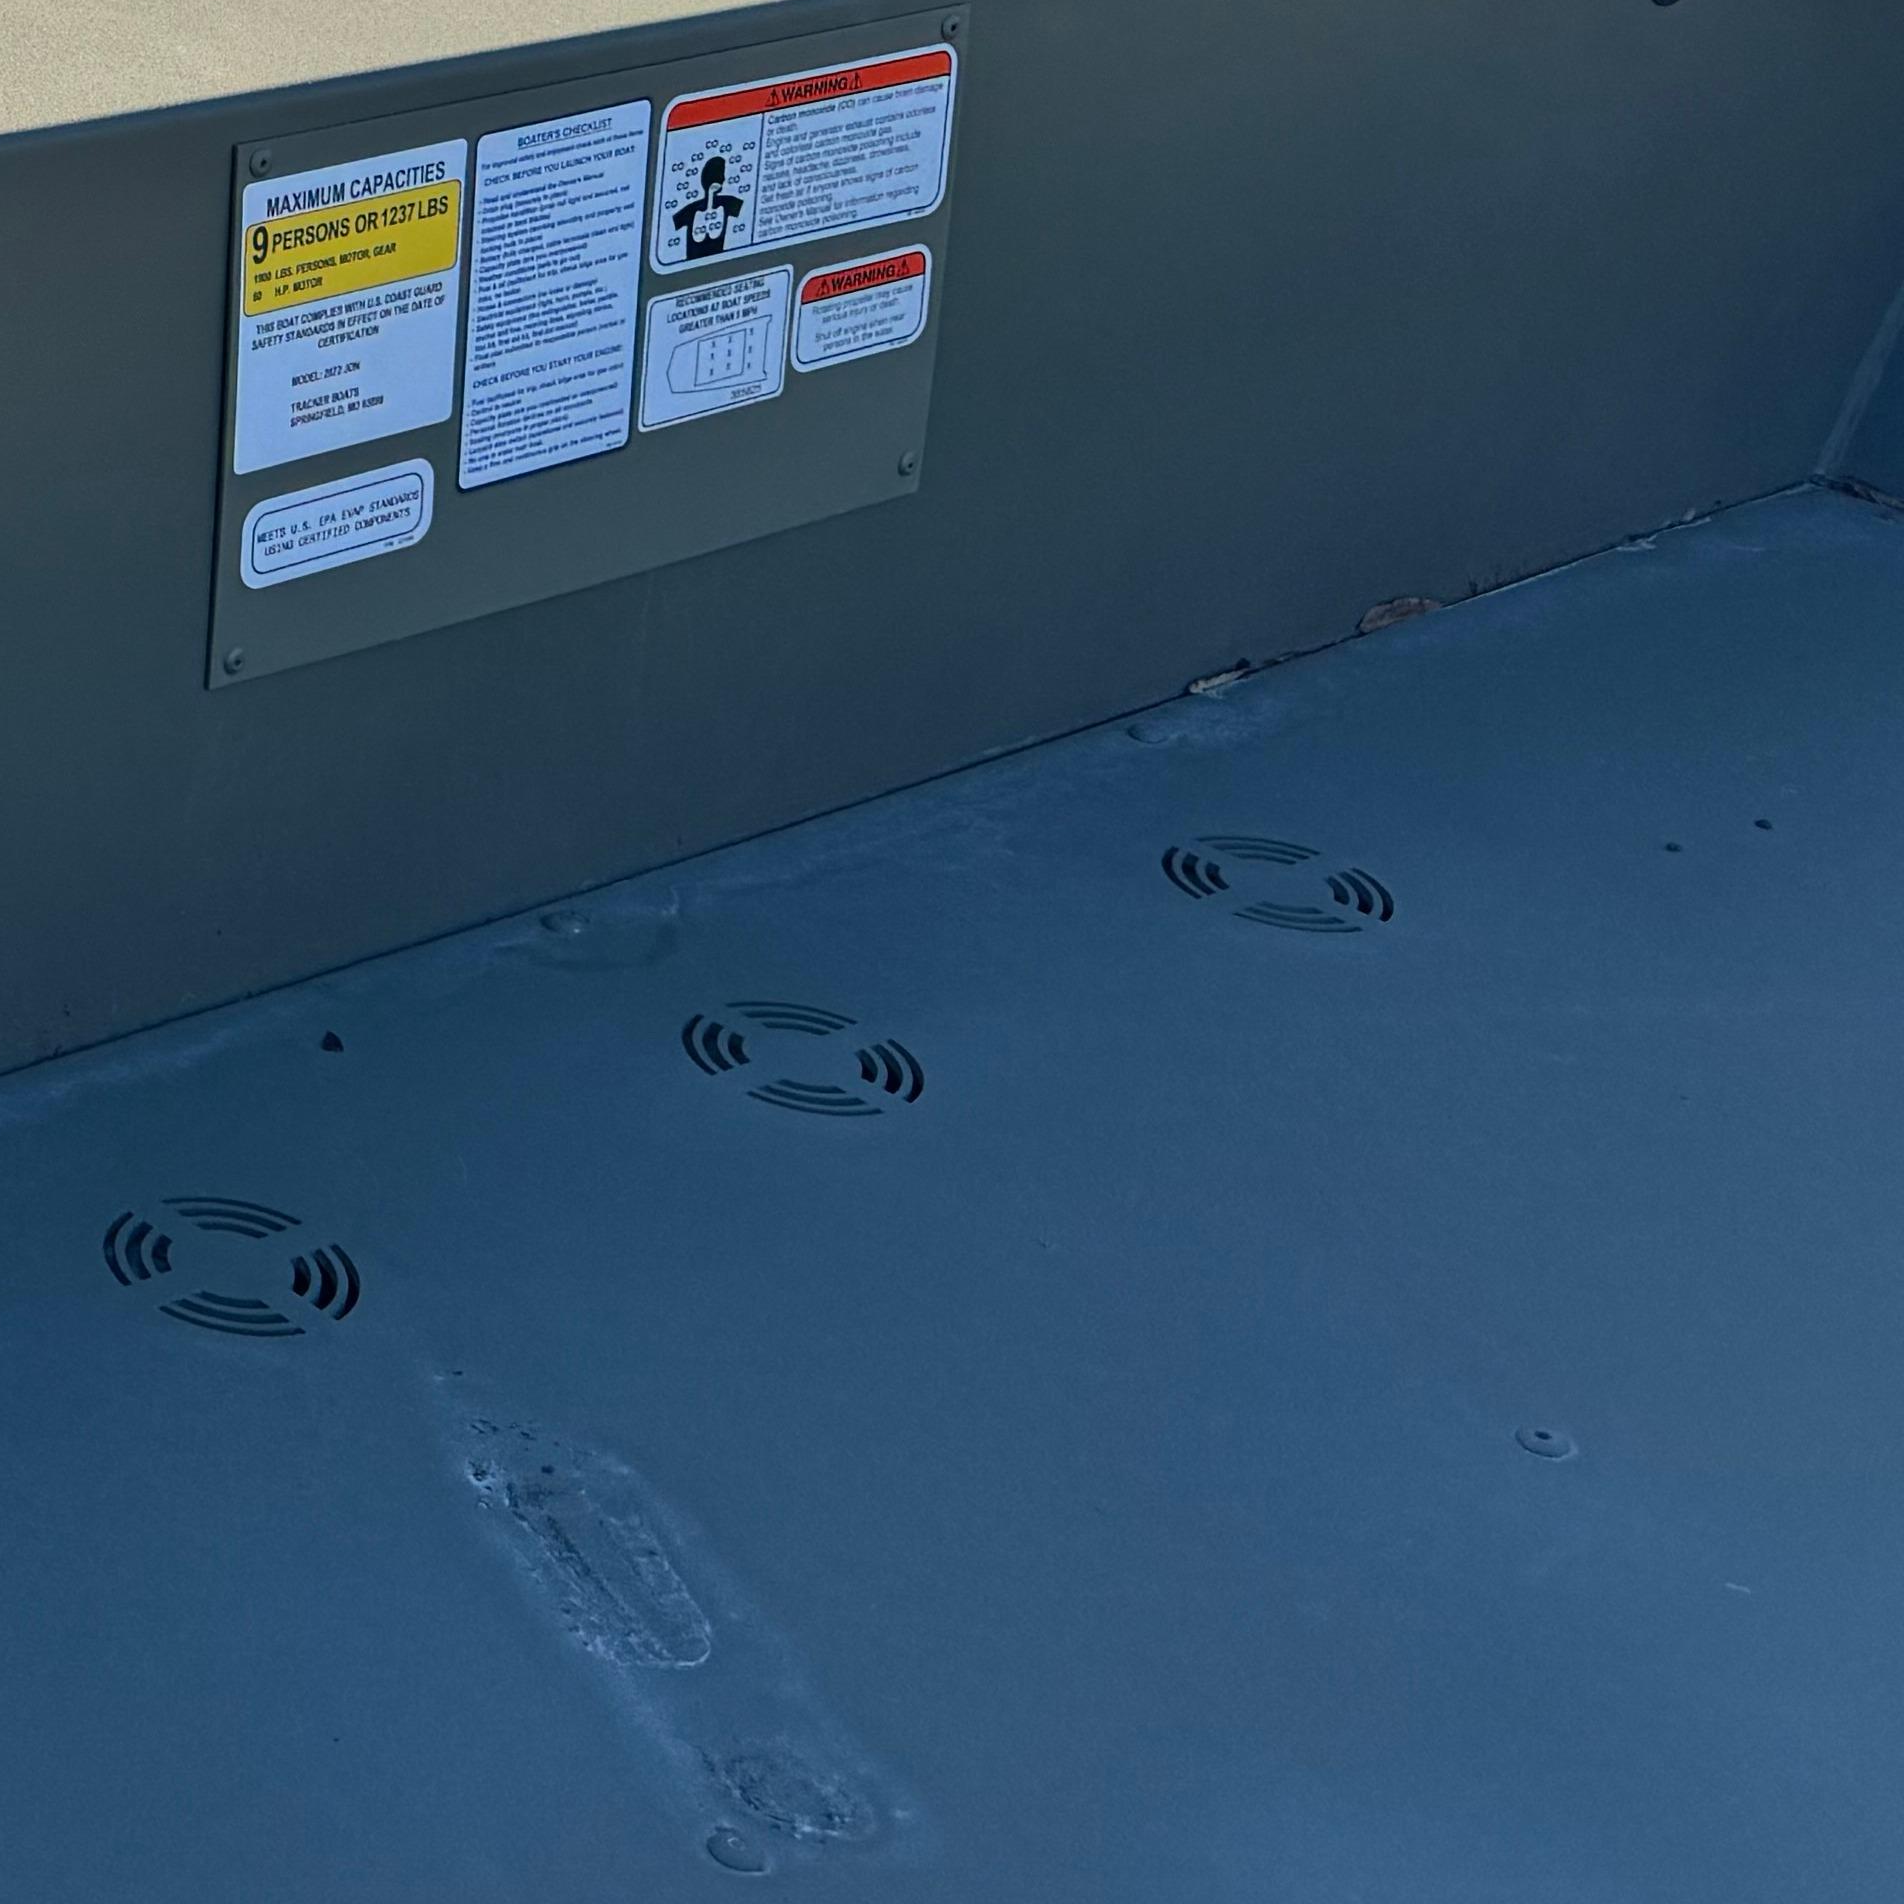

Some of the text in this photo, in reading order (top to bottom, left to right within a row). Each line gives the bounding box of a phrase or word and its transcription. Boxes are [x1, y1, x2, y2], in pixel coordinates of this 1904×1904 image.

[780, 76, 847, 103] WARNING
[517, 117, 612, 147] BOATER'S CHECKLIST
[484, 173, 509, 186] CHECK
[512, 166, 541, 180] BEFORE
[544, 162, 559, 172] YOU
[560, 155, 591, 169] LAUNCH
[592, 150, 612, 162] YOUR
[266, 182, 345, 217] MAXIMUM
[349, 160, 445, 199] CAPACITIES
[252, 224, 268, 265] 9
[271, 217, 350, 252] PERSONS
[354, 210, 378, 233] OR
[381, 202, 414, 228] 1237
[417, 195, 448, 220] LBS
[675, 275, 765, 307] RECOMMENDED SEATING
[831, 263, 895, 292] WARNING
[251, 294, 445, 351] SAFETY STANDARDS IN EFFECT ON THE DATE OF
[256, 280, 442, 335] THIS BOAT COMPLIES WITH U.S. COAST GUARD
[666, 288, 770, 323] LOCATIONS AT BOAT SPEEDS
[317, 323, 379, 349] CERTIFICATION
[291, 386, 359, 412] TRACKER BOATS
[257, 489, 419, 543] MEETS U.S. EPA EVAP STANDARDS
[264, 505, 411, 556] USING CERTIFIED COMPONENTS
